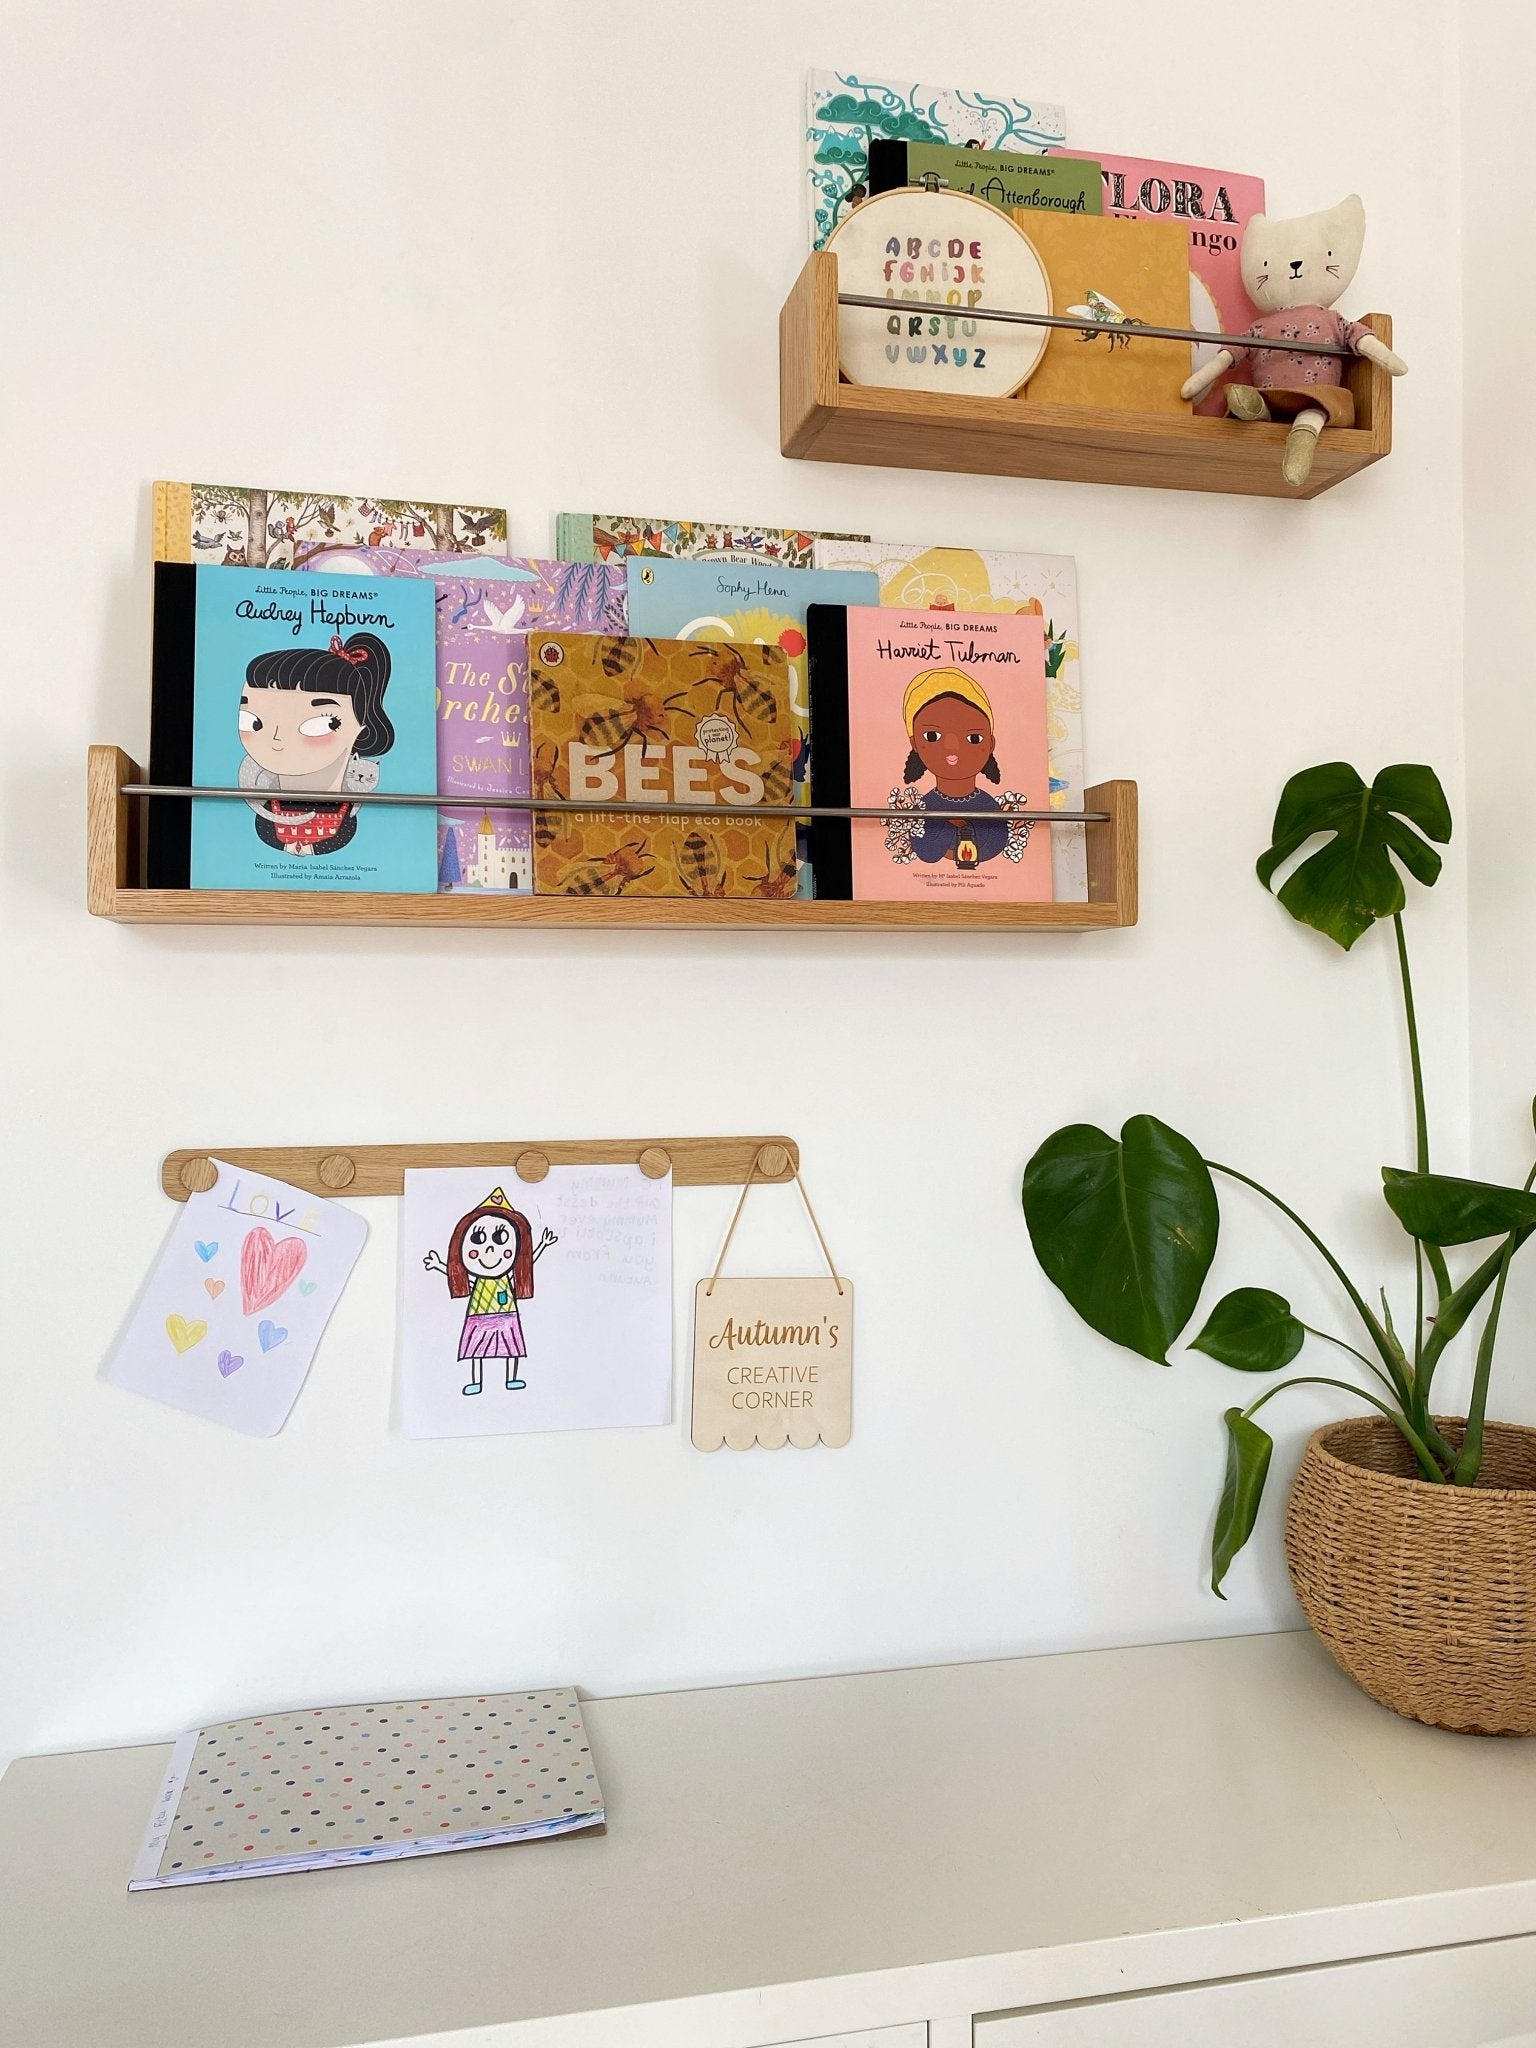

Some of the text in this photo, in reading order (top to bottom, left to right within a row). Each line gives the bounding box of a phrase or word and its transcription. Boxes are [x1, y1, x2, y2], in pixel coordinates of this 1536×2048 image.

[955, 160, 973, 168] Little
[1000, 164, 1014, 173] BIG
[981, 177, 1086, 213] Attenborough
[751, 557, 773, 567] Wo
[255, 585, 277, 594] Little
[311, 589, 328, 597] BIG
[716, 576, 789, 601] Sophy Henn
[235, 599, 395, 635] Audrey Hepburn
[900, 621, 918, 629] Little
[945, 623, 960, 631] BIG
[963, 624, 998, 633] DREAMS
[877, 638, 1021, 664] Harriet Tubman
[445, 661, 491, 687] The
[435, 686, 529, 724] rche
[704, 733, 731, 747] planet!
[453, 755, 512, 775] SWAN
[568, 742, 765, 806] BEES
[575, 811, 762, 831] a lift-the-flap eco book
[254, 862, 278, 870] Written
[709, 1316, 839, 1351] Autumn's
[727, 1366, 819, 1385] CREATIVE
[732, 1391, 814, 1409] CORNER
